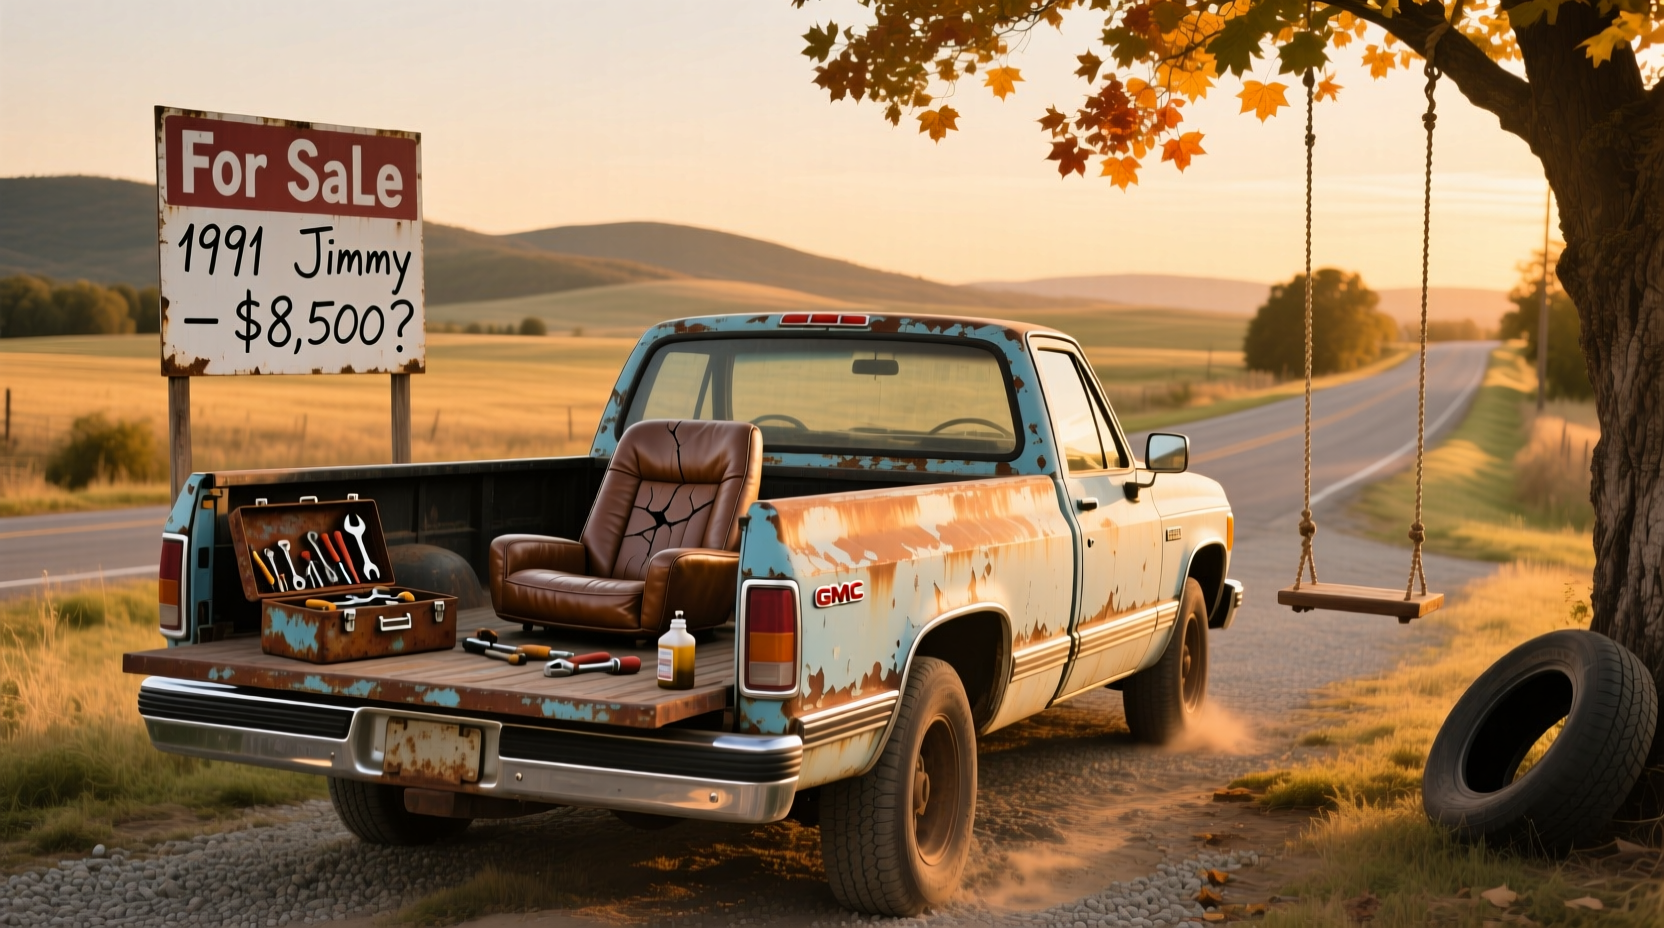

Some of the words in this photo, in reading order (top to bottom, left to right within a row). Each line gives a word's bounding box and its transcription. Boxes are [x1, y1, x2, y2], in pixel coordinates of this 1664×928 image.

[182, 129, 268, 198] For
[178, 223, 263, 277] 1991
[294, 226, 412, 295] Jimmy
[234, 288, 414, 355] $8,500?
[815, 580, 864, 607] GMC
